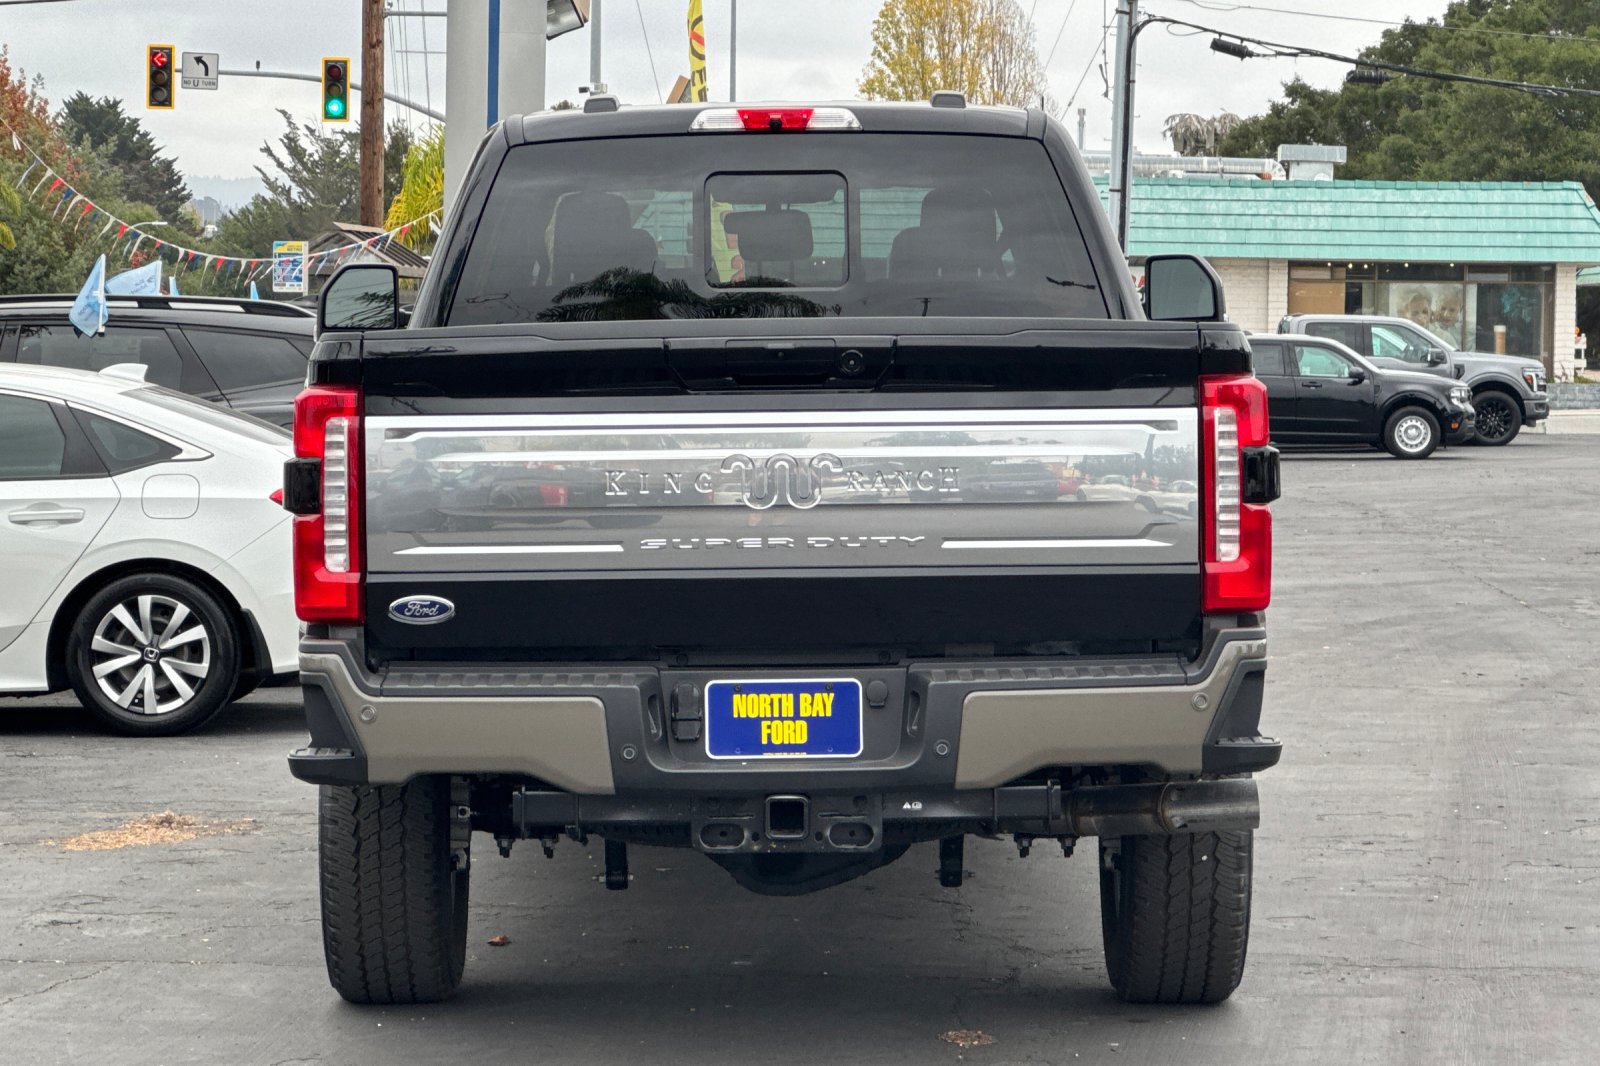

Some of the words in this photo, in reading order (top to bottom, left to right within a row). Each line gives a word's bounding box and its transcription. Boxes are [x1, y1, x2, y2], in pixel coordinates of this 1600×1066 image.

[193, 79, 199, 87] U
[604, 470, 713, 496] KING
[846, 467, 960, 492] RANCH
[640, 537, 795, 549] SUPER
[807, 536, 926, 548] DUTY
[404, 600, 440, 616] Ford
[733, 693, 794, 718] NORTH
[800, 693, 835, 717] BAY
[761, 720, 808, 745] FORD
